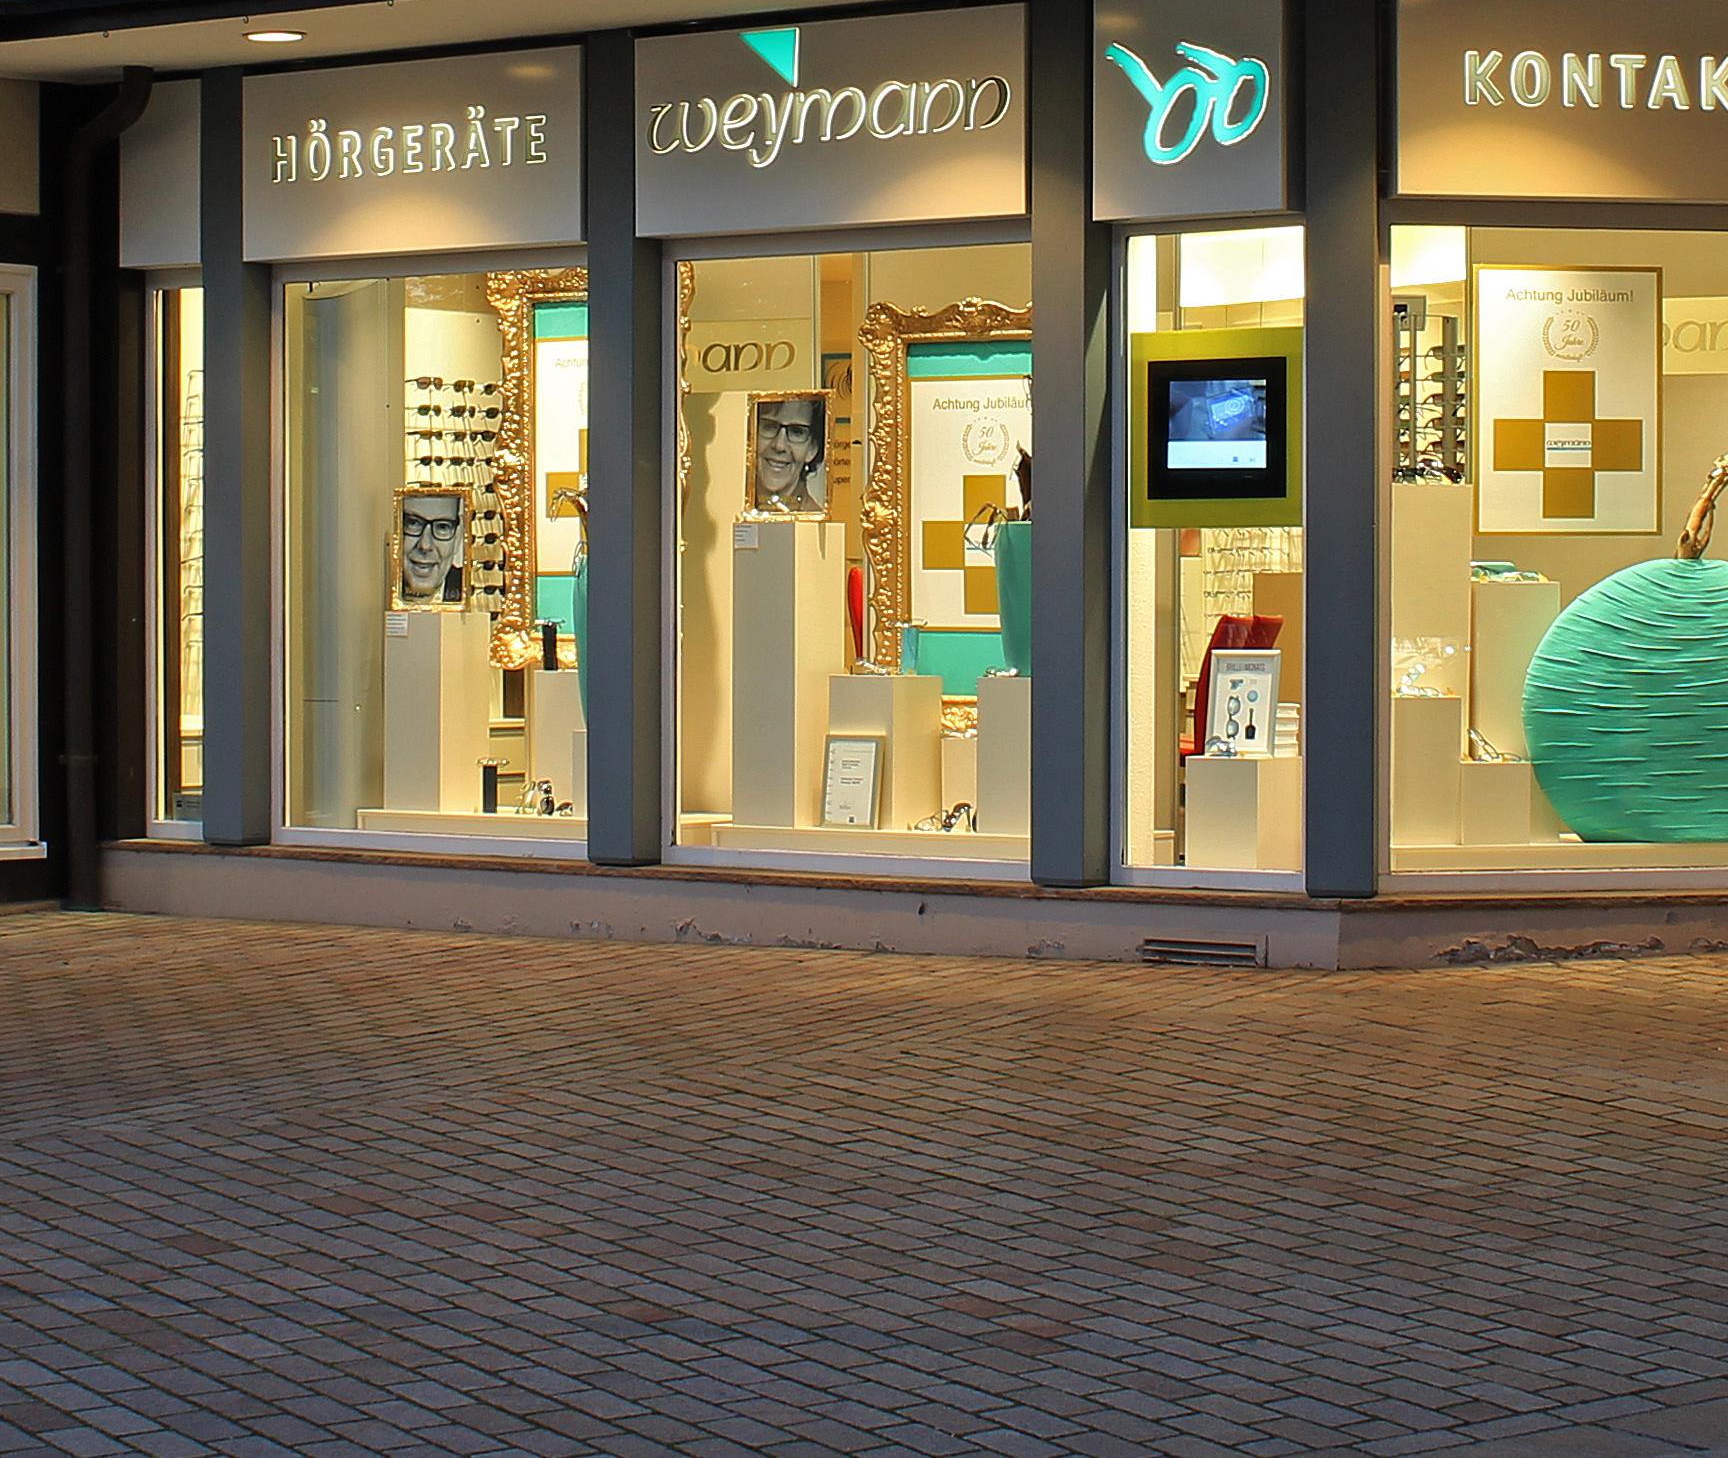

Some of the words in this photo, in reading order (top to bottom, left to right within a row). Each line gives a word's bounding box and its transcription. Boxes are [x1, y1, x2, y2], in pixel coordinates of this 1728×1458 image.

[647, 71, 1013, 168] weymann
[272, 106, 548, 184] HÖRGERÄTE
[1506, 289, 1563, 305] Achtung
[1567, 288, 1634, 303] Jubiläum!
[1562, 320, 1581, 332] 50
[933, 398, 980, 412] Achtung
[978, 426, 994, 438] 50
